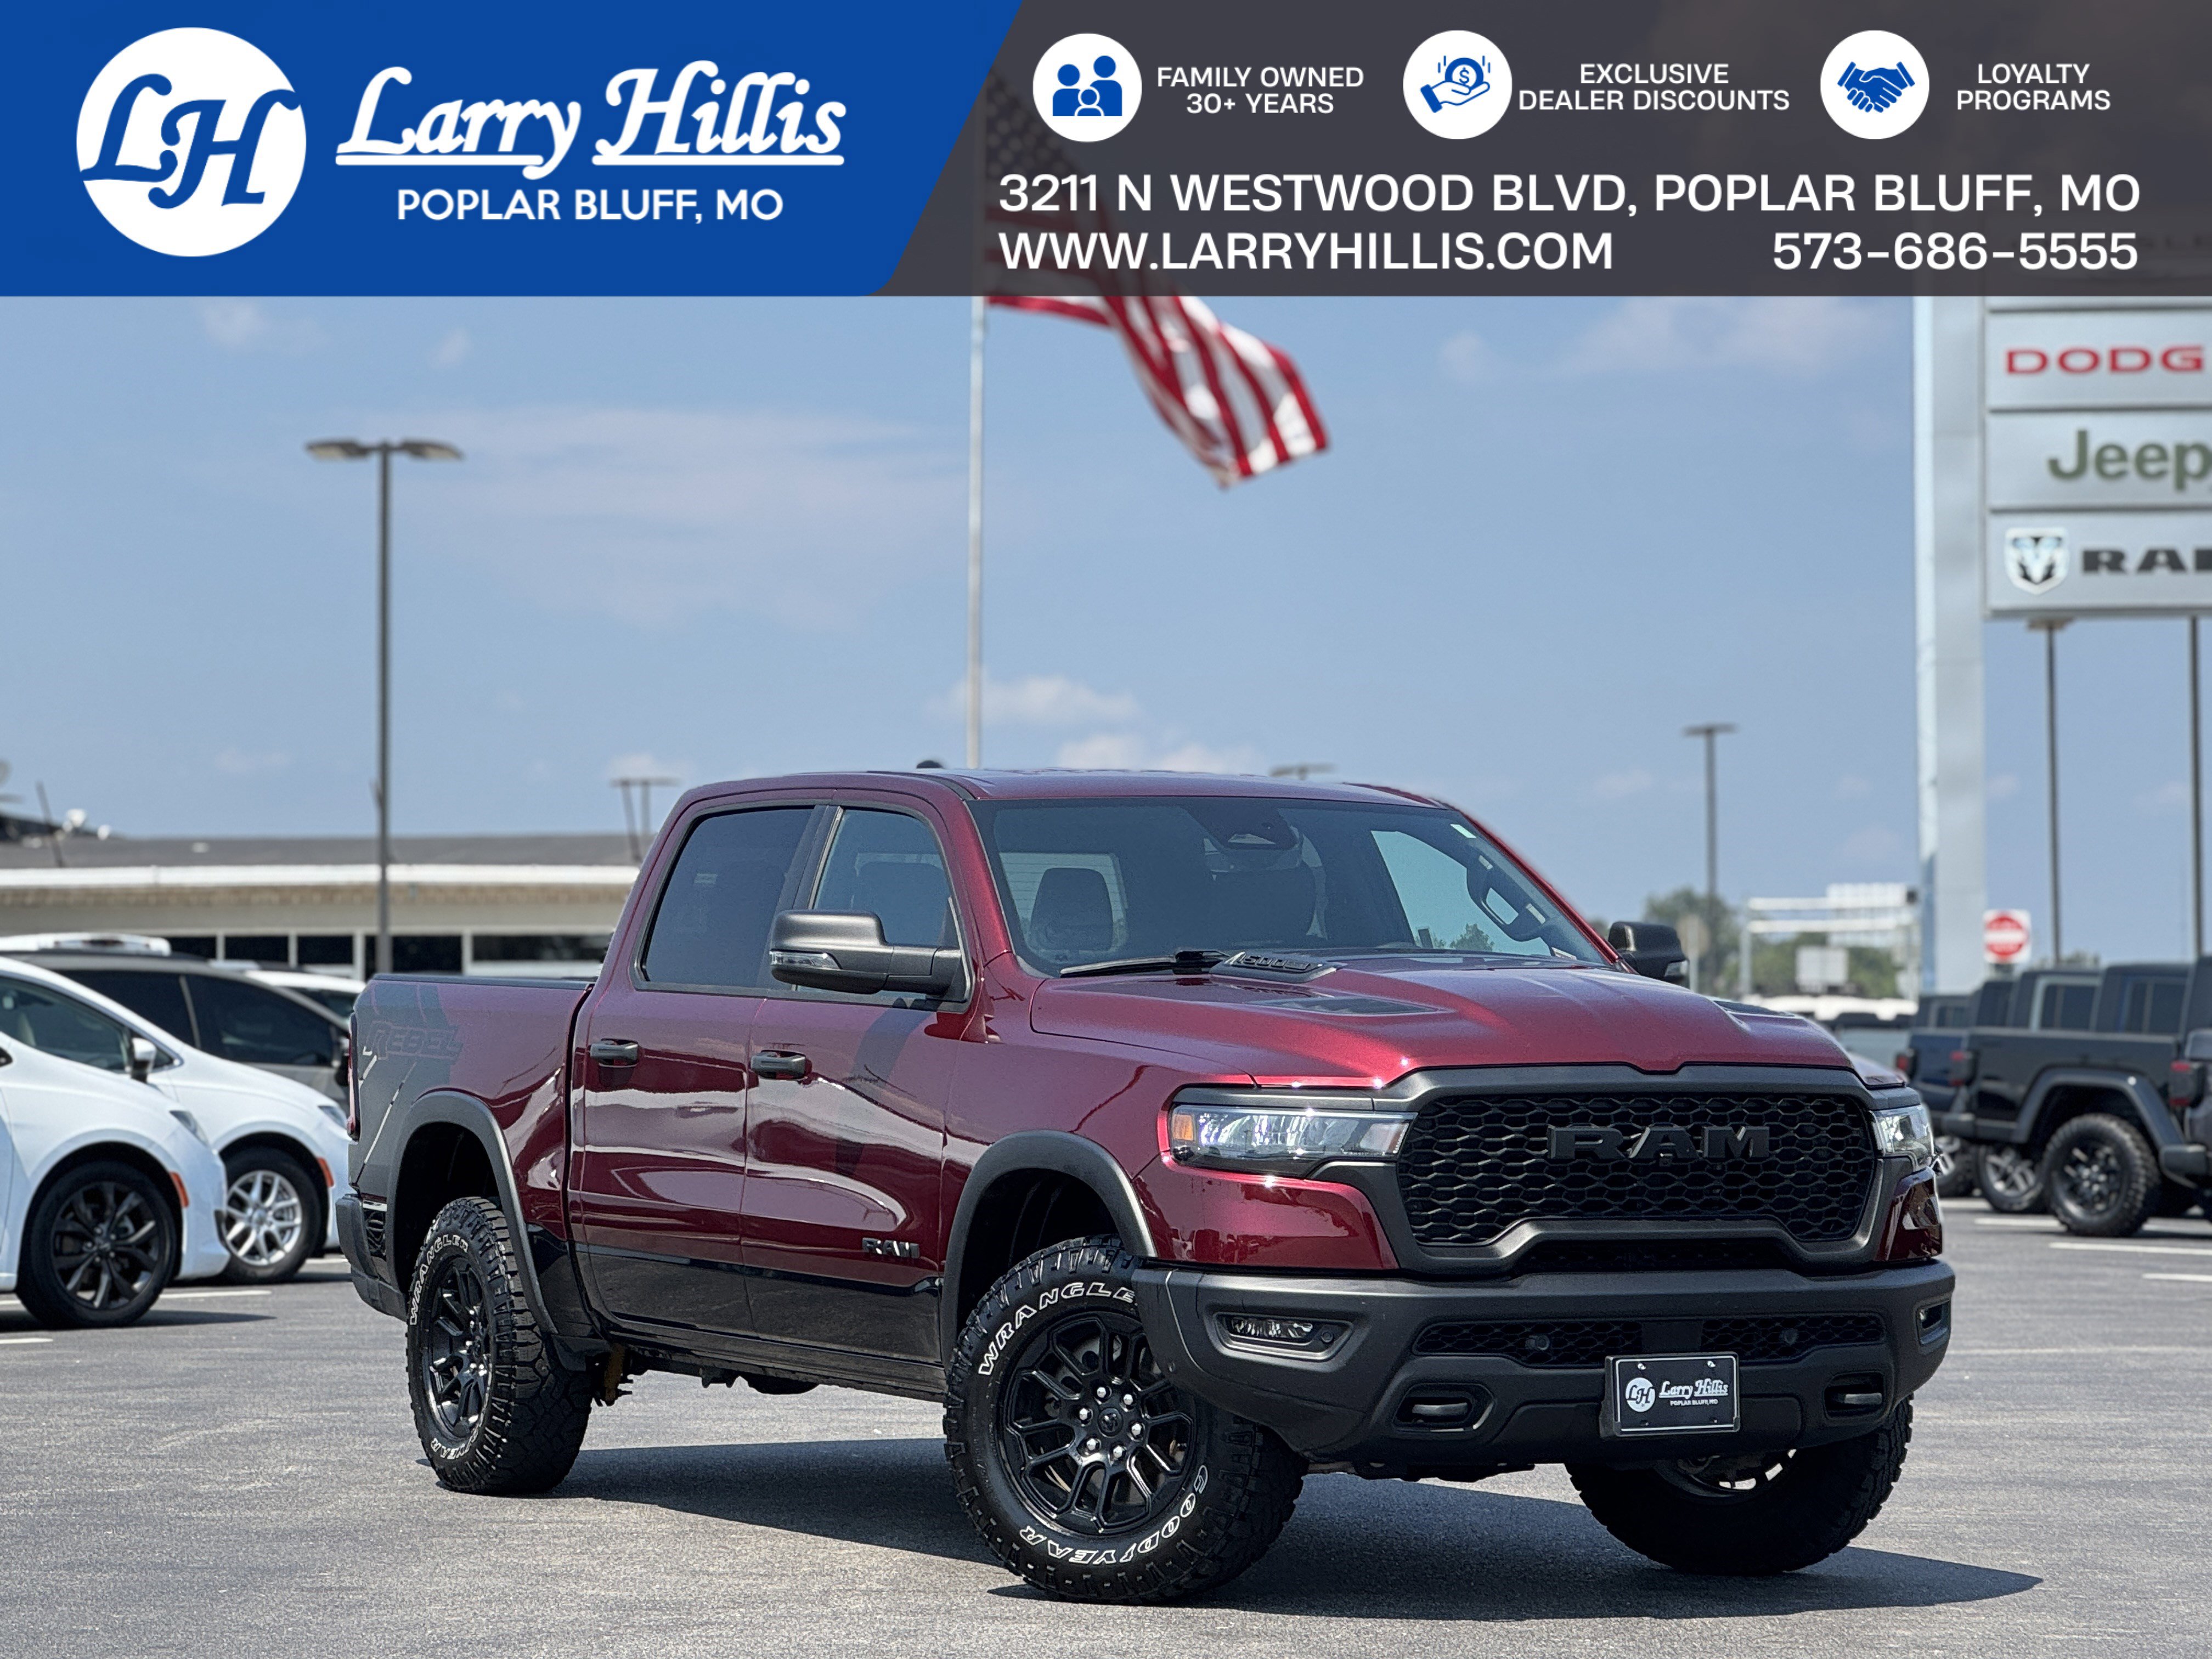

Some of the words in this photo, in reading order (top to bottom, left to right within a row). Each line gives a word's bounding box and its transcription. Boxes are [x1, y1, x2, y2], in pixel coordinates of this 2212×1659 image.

[2047, 430, 2212, 491] Jeep
[1547, 1125, 1770, 1160] RAM
[862, 1237, 920, 1259] RAM
[410, 1234, 469, 1325] WRANGLER
[978, 1282, 1138, 1375] WRANGLE
[1659, 1381, 1694, 1399] Larry
[1694, 1378, 1728, 1396] Hillis
[1019, 1465, 1209, 1565] GOODYEAR
